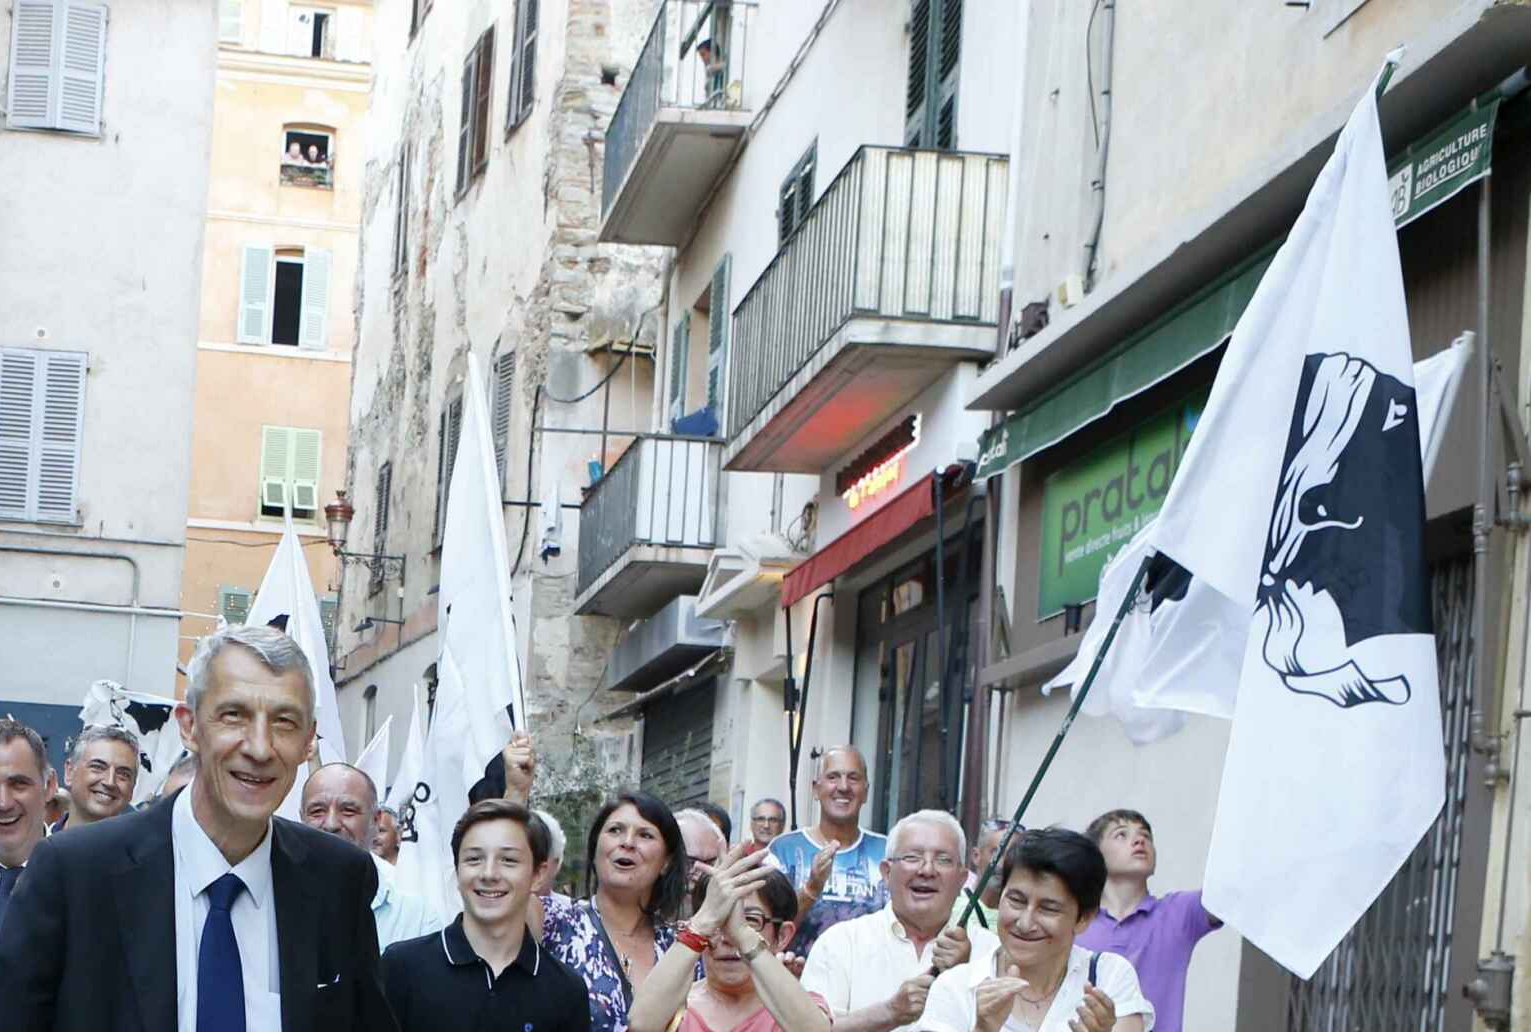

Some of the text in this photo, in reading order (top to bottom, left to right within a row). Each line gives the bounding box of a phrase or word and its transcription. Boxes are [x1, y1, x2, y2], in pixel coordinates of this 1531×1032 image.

[1414, 143, 1482, 196] BIOLOGIQU
[1416, 122, 1488, 178] AGRICULTURE
[1058, 409, 1191, 577] pratal
